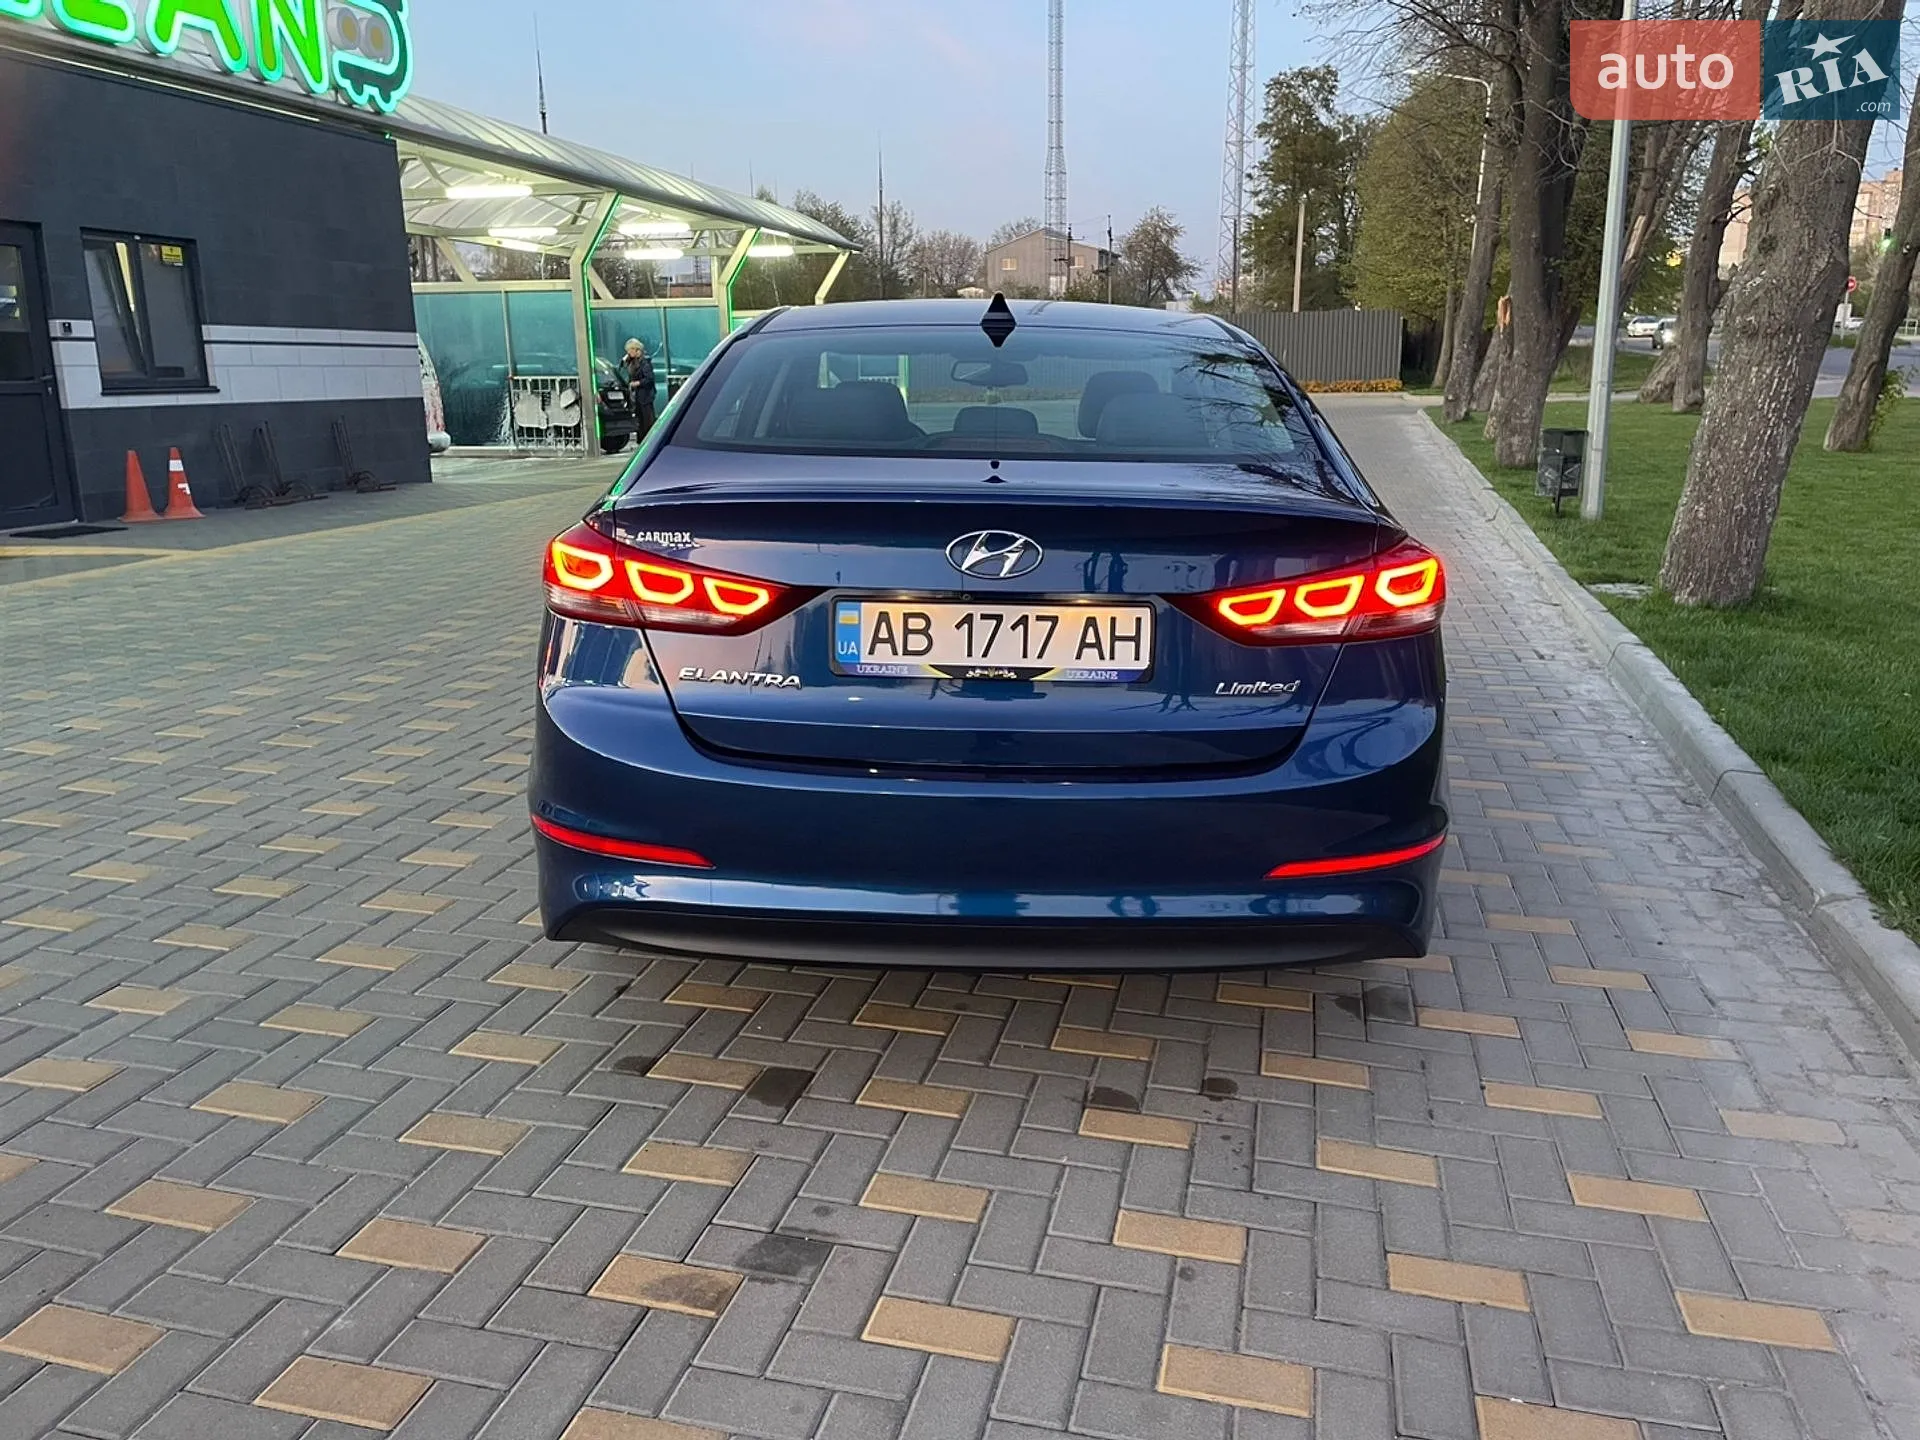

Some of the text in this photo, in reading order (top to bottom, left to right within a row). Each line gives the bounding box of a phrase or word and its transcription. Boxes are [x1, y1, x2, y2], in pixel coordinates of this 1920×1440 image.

[867, 610, 1143, 661] AB 1717 AH
[838, 640, 858, 656] UA
[856, 664, 908, 675] UKRAINE
[1064, 669, 1118, 680] UKRAINE
[679, 667, 802, 690] ELANTRA
[1215, 680, 1301, 695] Limited
